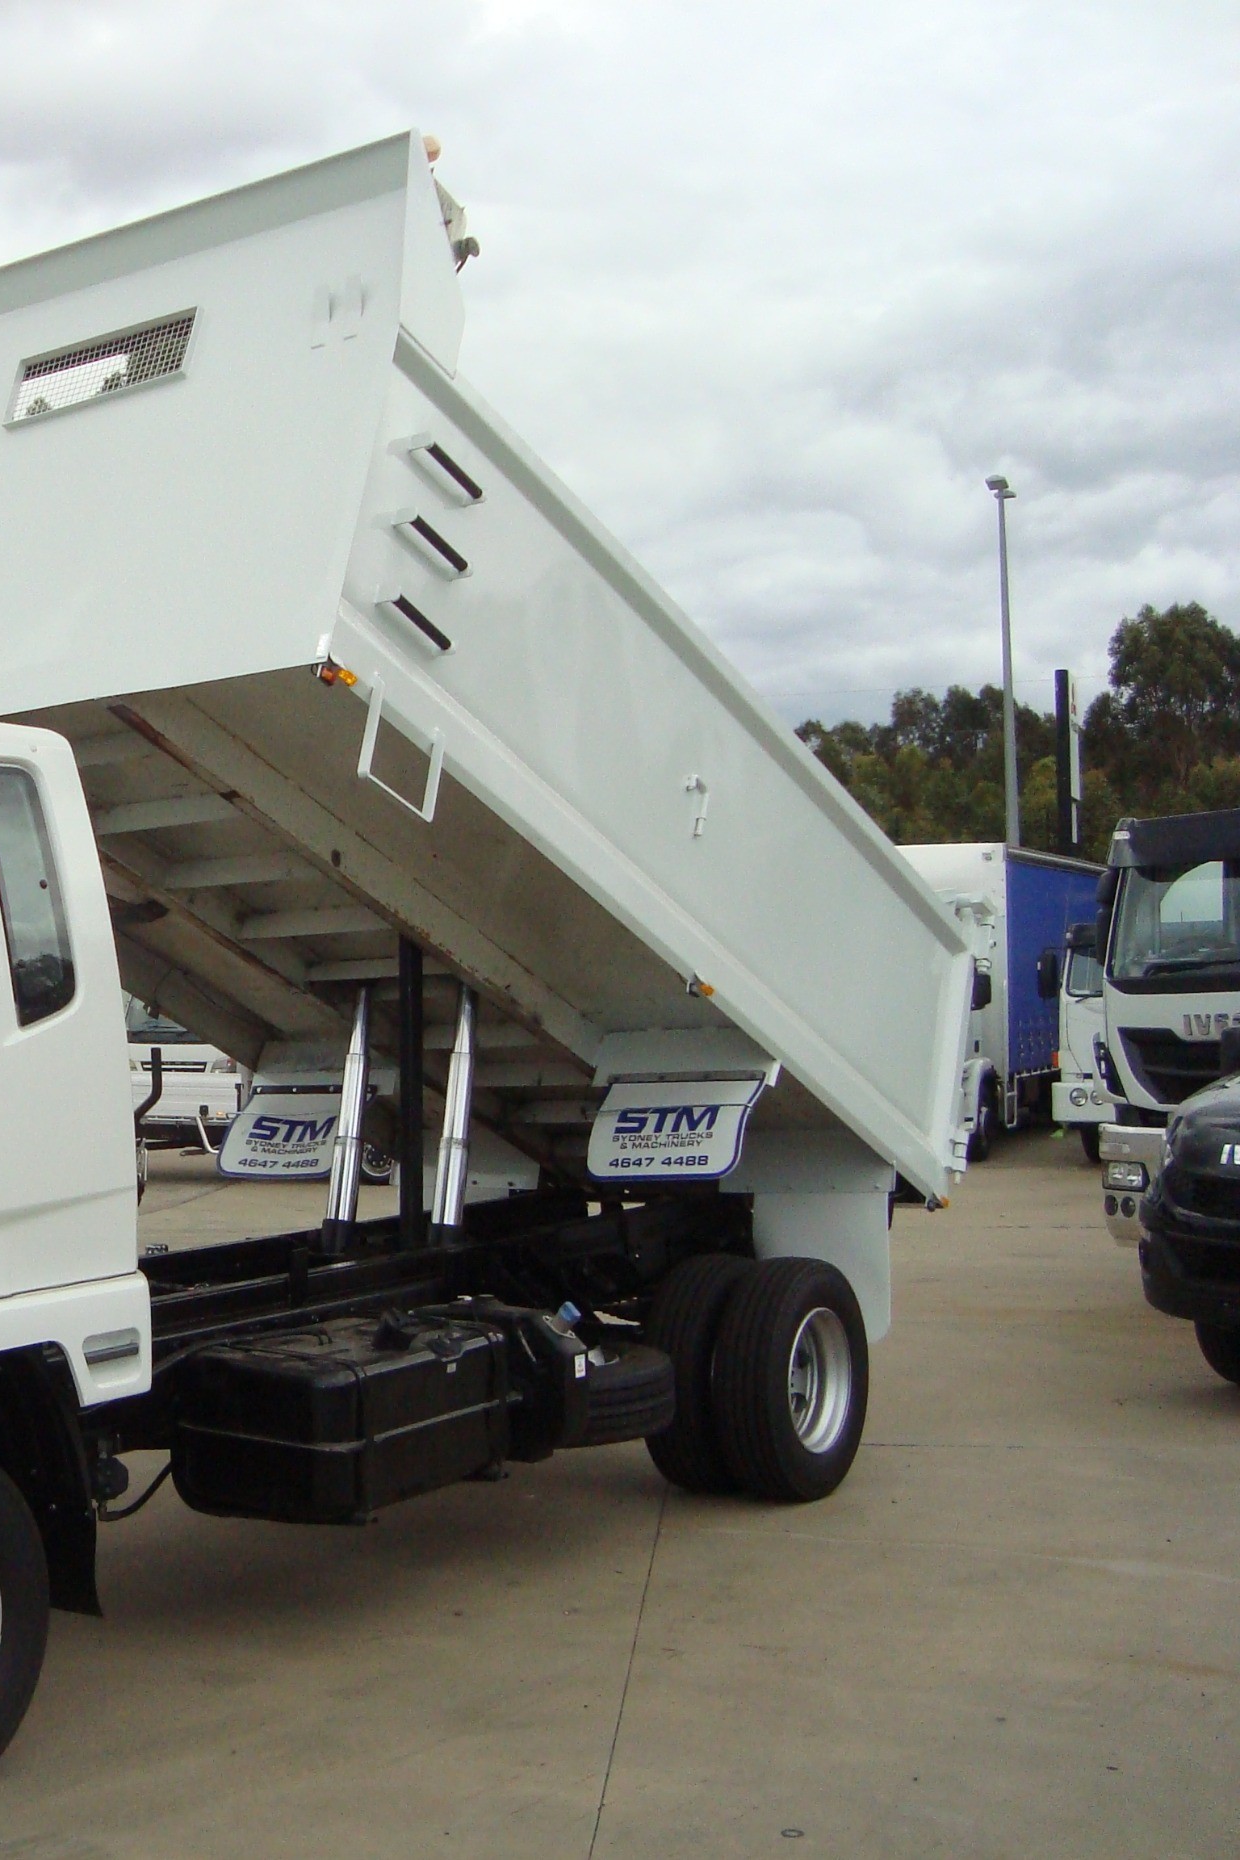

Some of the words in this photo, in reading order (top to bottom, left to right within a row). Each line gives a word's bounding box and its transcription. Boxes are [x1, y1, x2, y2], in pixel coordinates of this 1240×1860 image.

[1182, 1012, 1240, 1037] IVE
[614, 1104, 720, 1134] STM
[247, 1115, 338, 1143] STM
[612, 1133, 661, 1143] SYDNEY
[666, 1131, 714, 1141] TRUCKS
[245, 1139, 288, 1149] SYDNEY
[291, 1139, 327, 1149] TRUCKS
[620, 1141, 629, 1150] &
[631, 1139, 703, 1150] MACHINERY
[261, 1146, 318, 1155] MACHINERY
[238, 1158, 280, 1169] 4647
[281, 1158, 320, 1169] 4488
[608, 1156, 656, 1169] 4647
[660, 1154, 710, 1168] 4488
